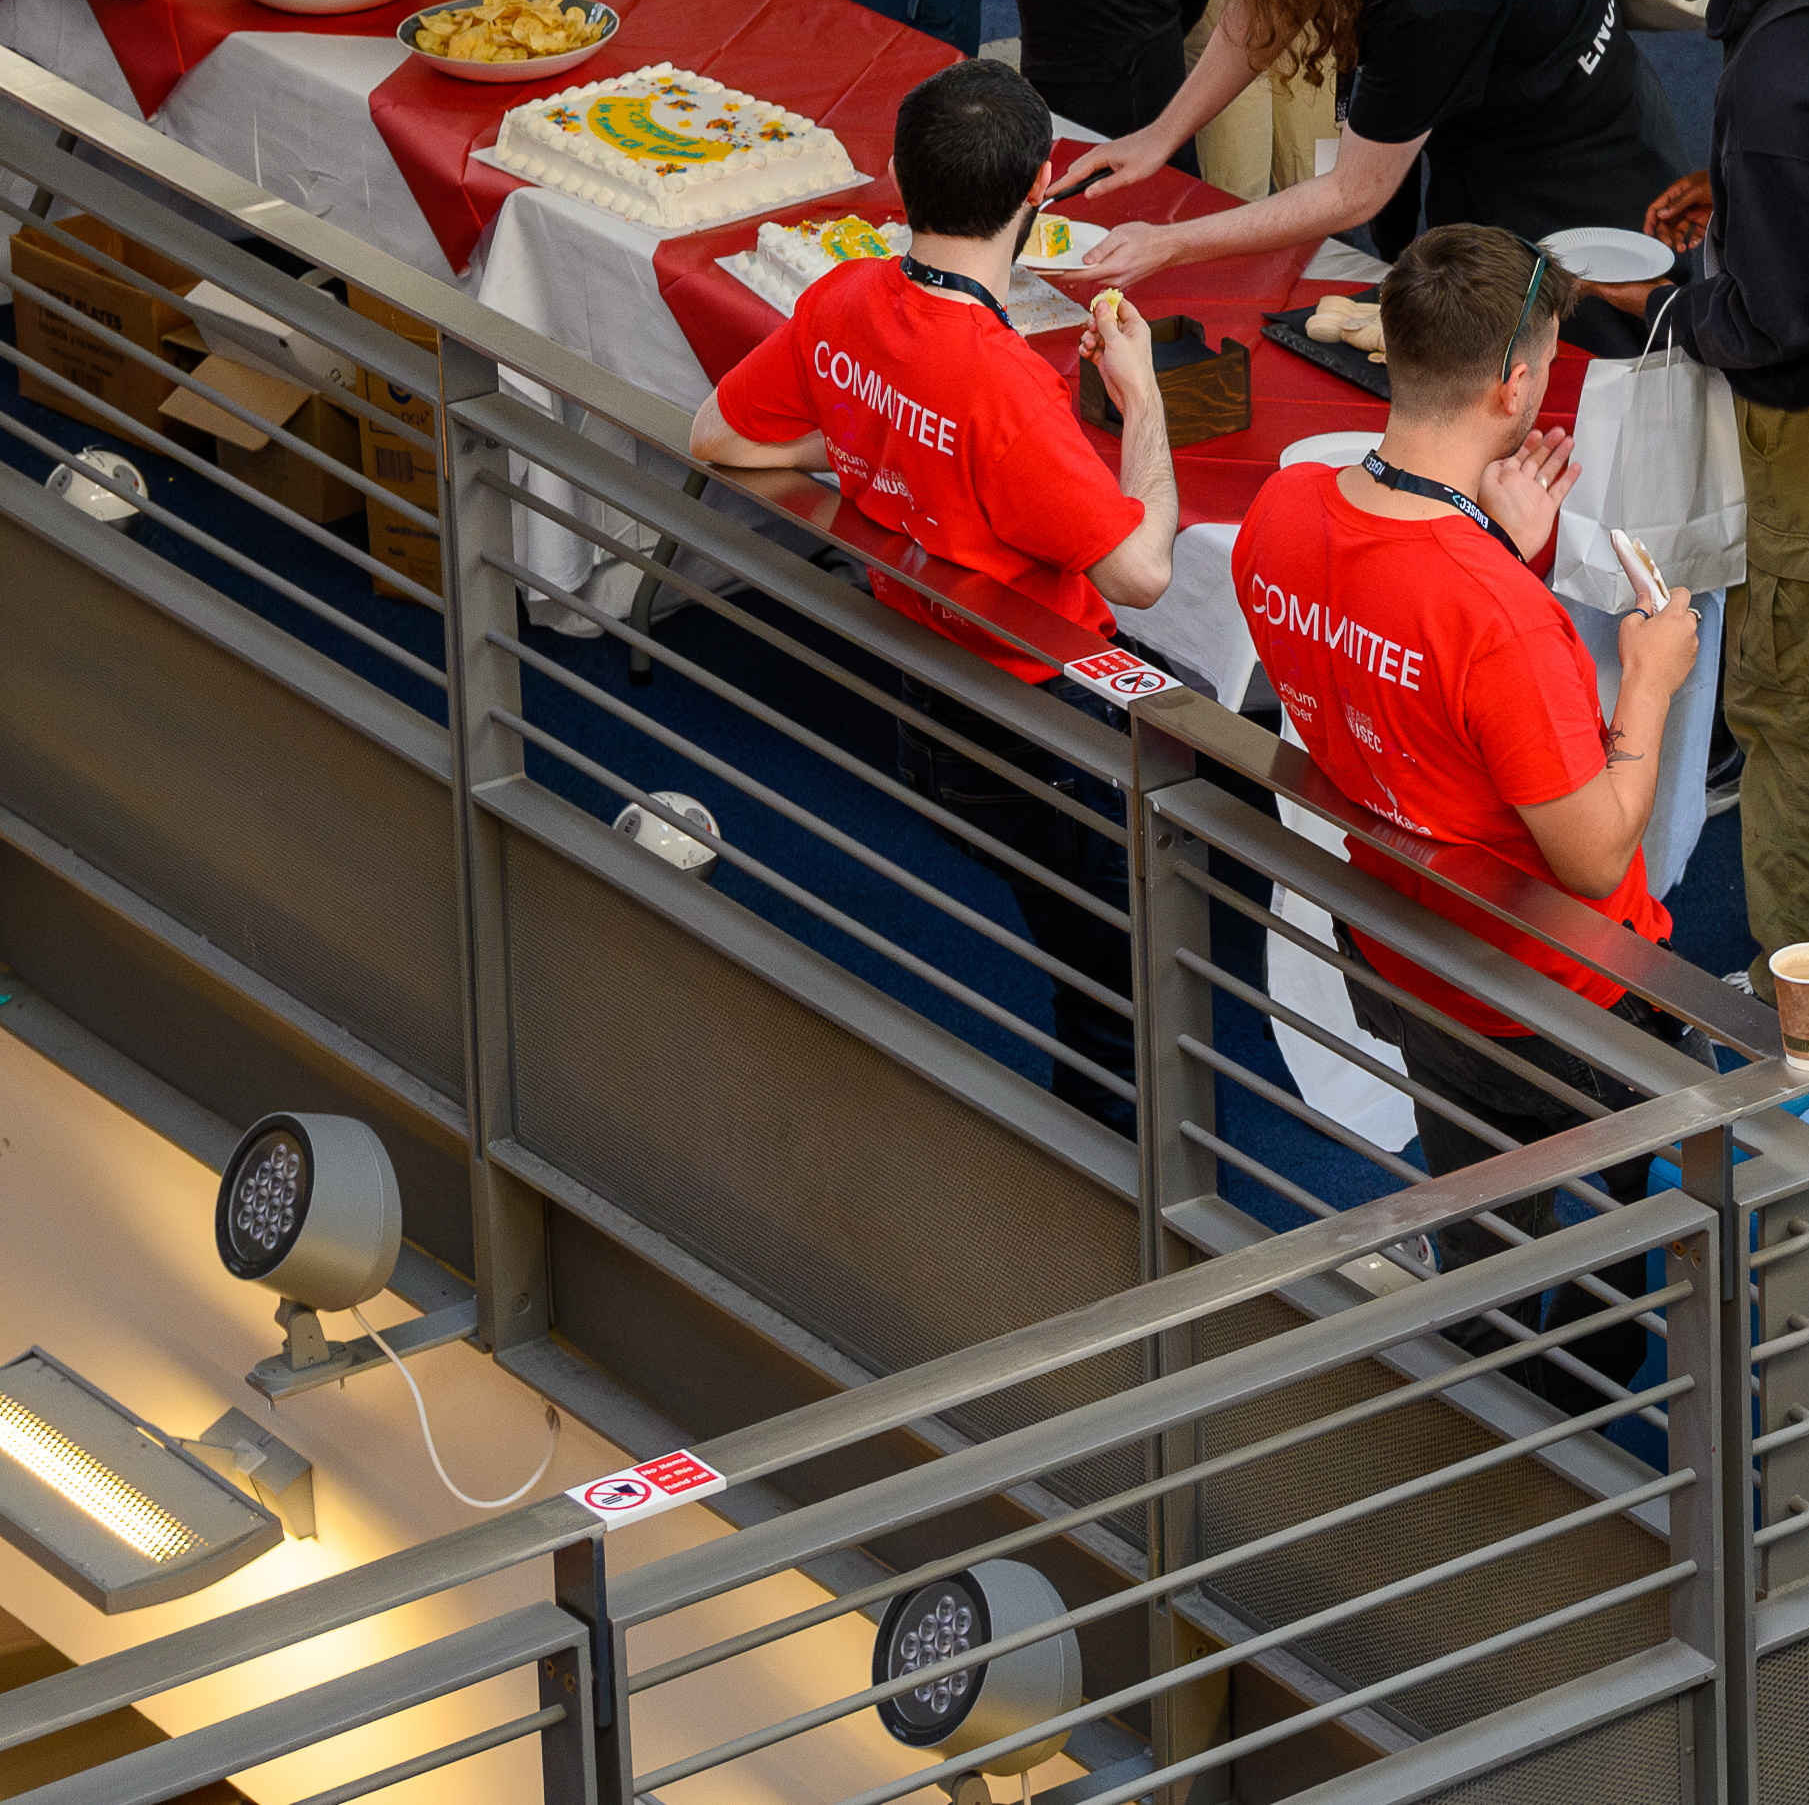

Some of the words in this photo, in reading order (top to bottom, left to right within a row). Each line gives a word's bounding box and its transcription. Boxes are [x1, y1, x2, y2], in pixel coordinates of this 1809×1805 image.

[814, 341, 957, 456] COMMITTEE
[1252, 573, 1424, 692] COMMITTEE
[641, 1467, 658, 1477] No
[659, 1457, 689, 1471] items
[658, 1473, 673, 1482] on
[674, 1465, 695, 1476] this
[664, 1478, 691, 1492] hand
[692, 1471, 709, 1482] rail
